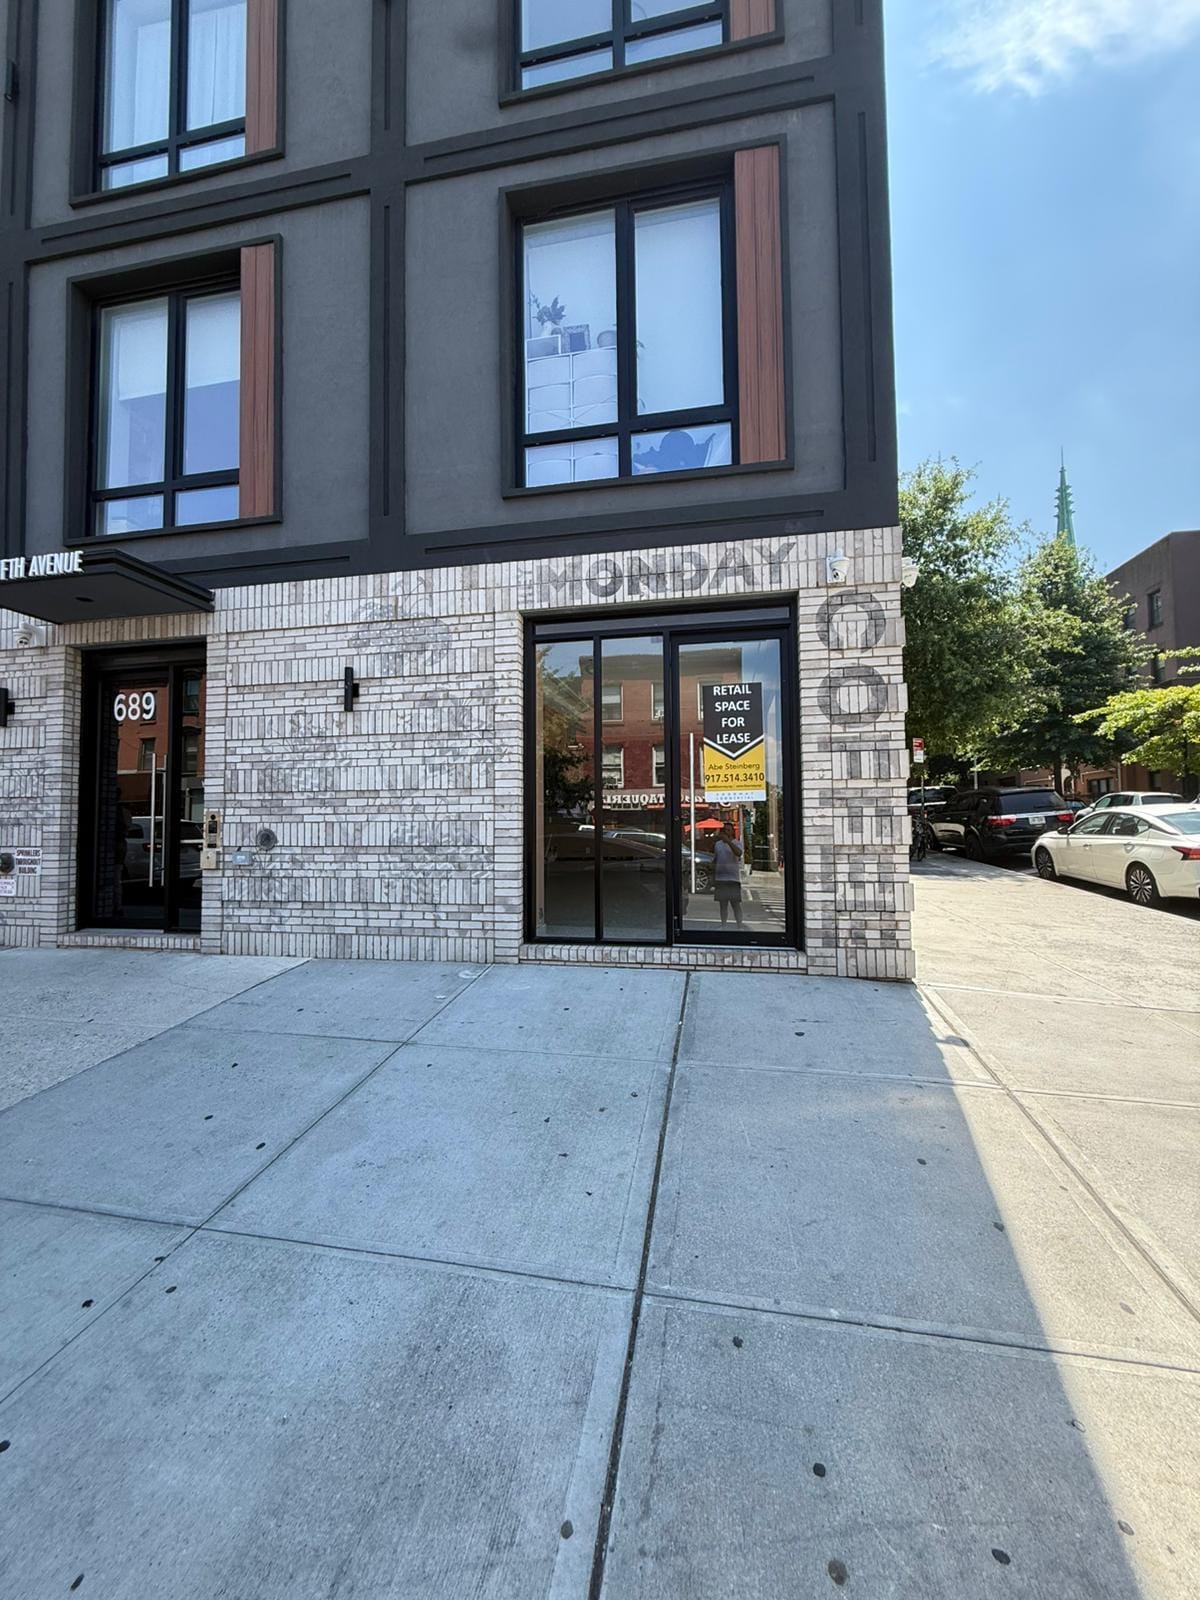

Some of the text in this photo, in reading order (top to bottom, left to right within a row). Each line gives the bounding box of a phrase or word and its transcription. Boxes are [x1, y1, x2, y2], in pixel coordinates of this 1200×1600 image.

[28, 550, 84, 577] AVENUE
[536, 541, 797, 603] MONDAY
[713, 684, 752, 696] RETAIL
[114, 691, 155, 721] 689
[714, 700, 751, 712] SPACE
[721, 716, 746, 728] FOR
[716, 732, 751, 744] LEASE
[708, 763, 760, 772] Abe Steinberg
[816, 588, 897, 950] COFFEE
[705, 772, 765, 783] 917.514.3410
